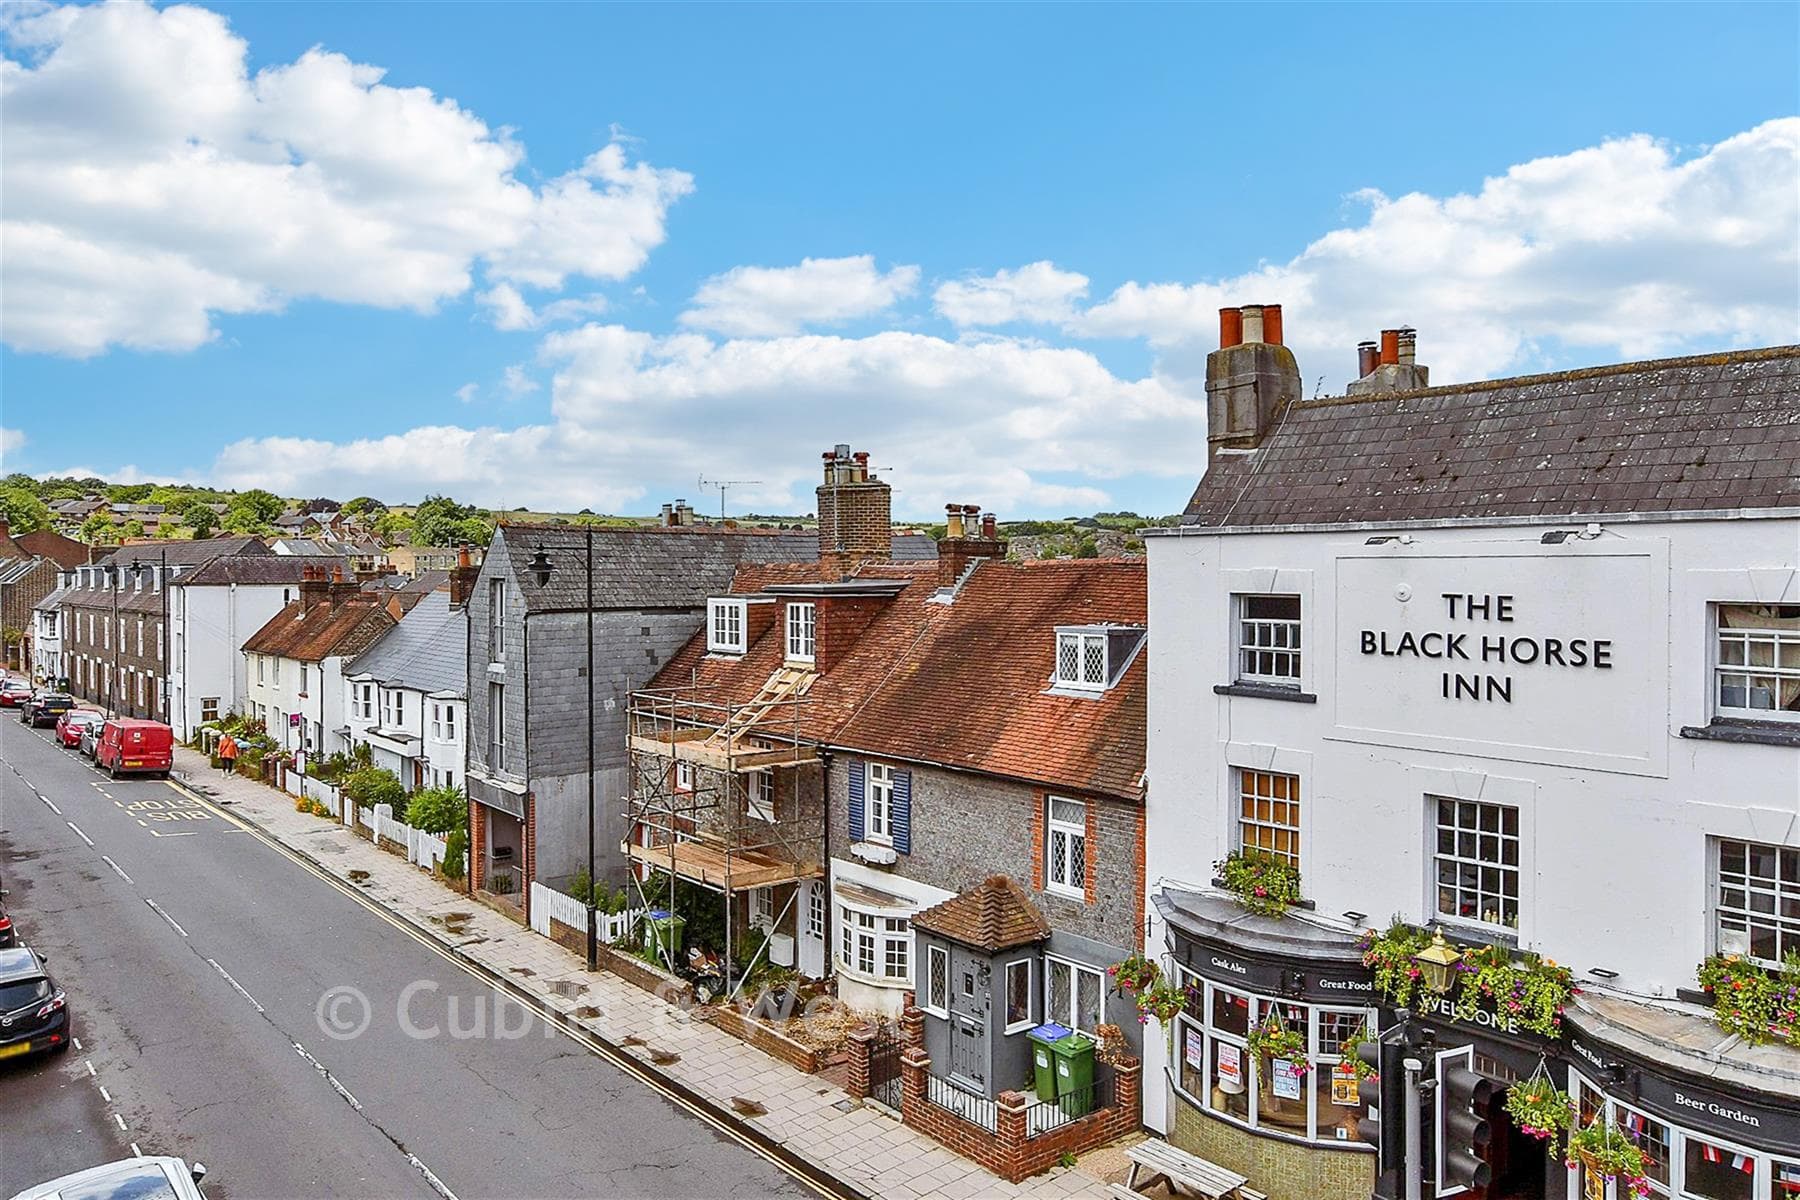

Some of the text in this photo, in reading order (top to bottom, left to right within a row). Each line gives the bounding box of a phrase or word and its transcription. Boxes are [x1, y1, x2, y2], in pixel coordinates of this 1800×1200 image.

[1441, 593, 1514, 622] THE
[1360, 630, 1613, 669] BLACK HORSE
[1442, 672, 1512, 703] INN
[127, 800, 202, 811] STOP
[146, 810, 212, 821] BUS
[1211, 957, 1247, 974] Cask Ales
[1319, 979, 1372, 991] Great Food
[1674, 1093, 1761, 1127] Beer Garden
